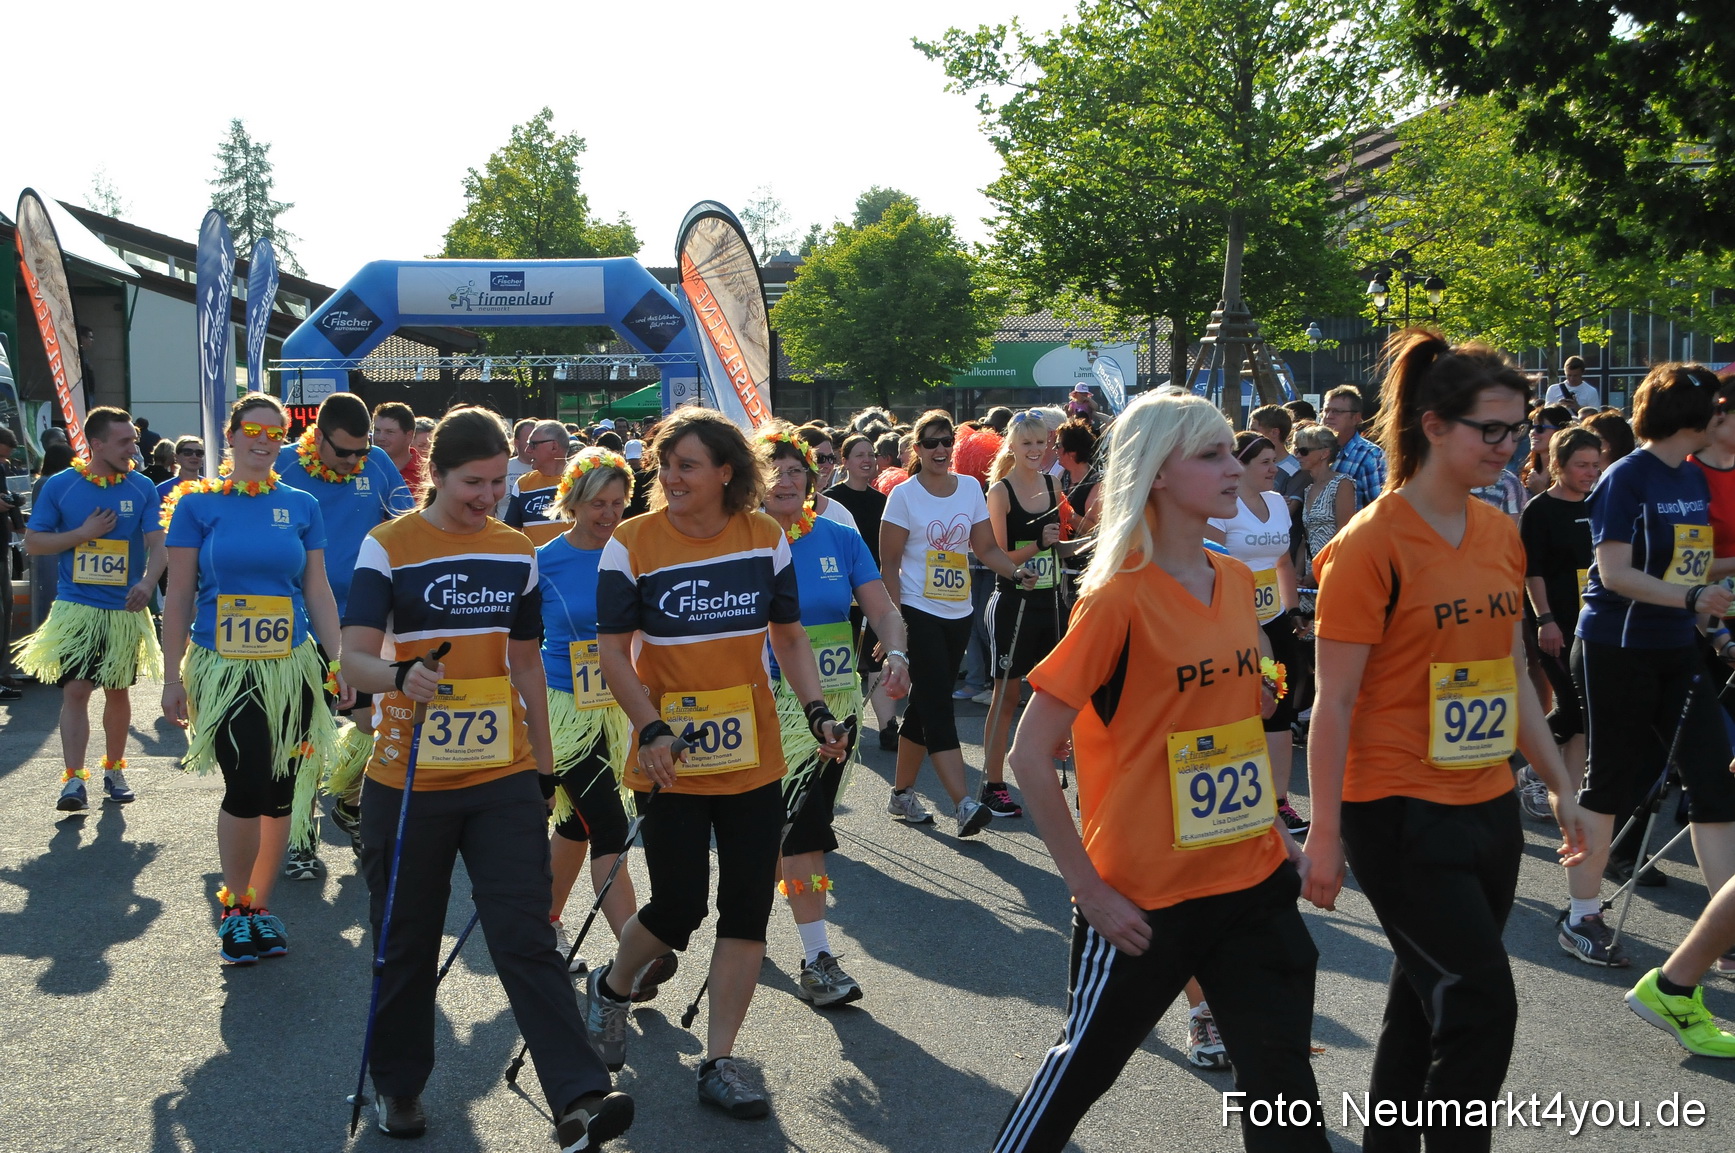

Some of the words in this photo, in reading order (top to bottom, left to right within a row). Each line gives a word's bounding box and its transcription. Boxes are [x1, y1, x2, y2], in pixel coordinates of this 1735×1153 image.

[478, 291, 555, 306] firmenlauf
[331, 317, 373, 327] Fischer
[1245, 532, 1290, 546] adida
[77, 554, 126, 574] 1164
[933, 568, 965, 589] 505
[442, 586, 515, 606] Fischer
[679, 590, 760, 613] Fischer
[450, 605, 511, 615] AUTOMOBILE
[688, 607, 756, 622] AUTOMOBILE
[220, 617, 290, 643] 1166
[576, 666, 607, 693] 11
[428, 710, 498, 746] 373
[1444, 698, 1507, 743] 922
[680, 717, 742, 754] 408
[1190, 761, 1262, 818] 923
[1212, 818, 1226, 826] Lisa
[1181, 827, 1236, 841] PE-Kunststoff-Fabrik
